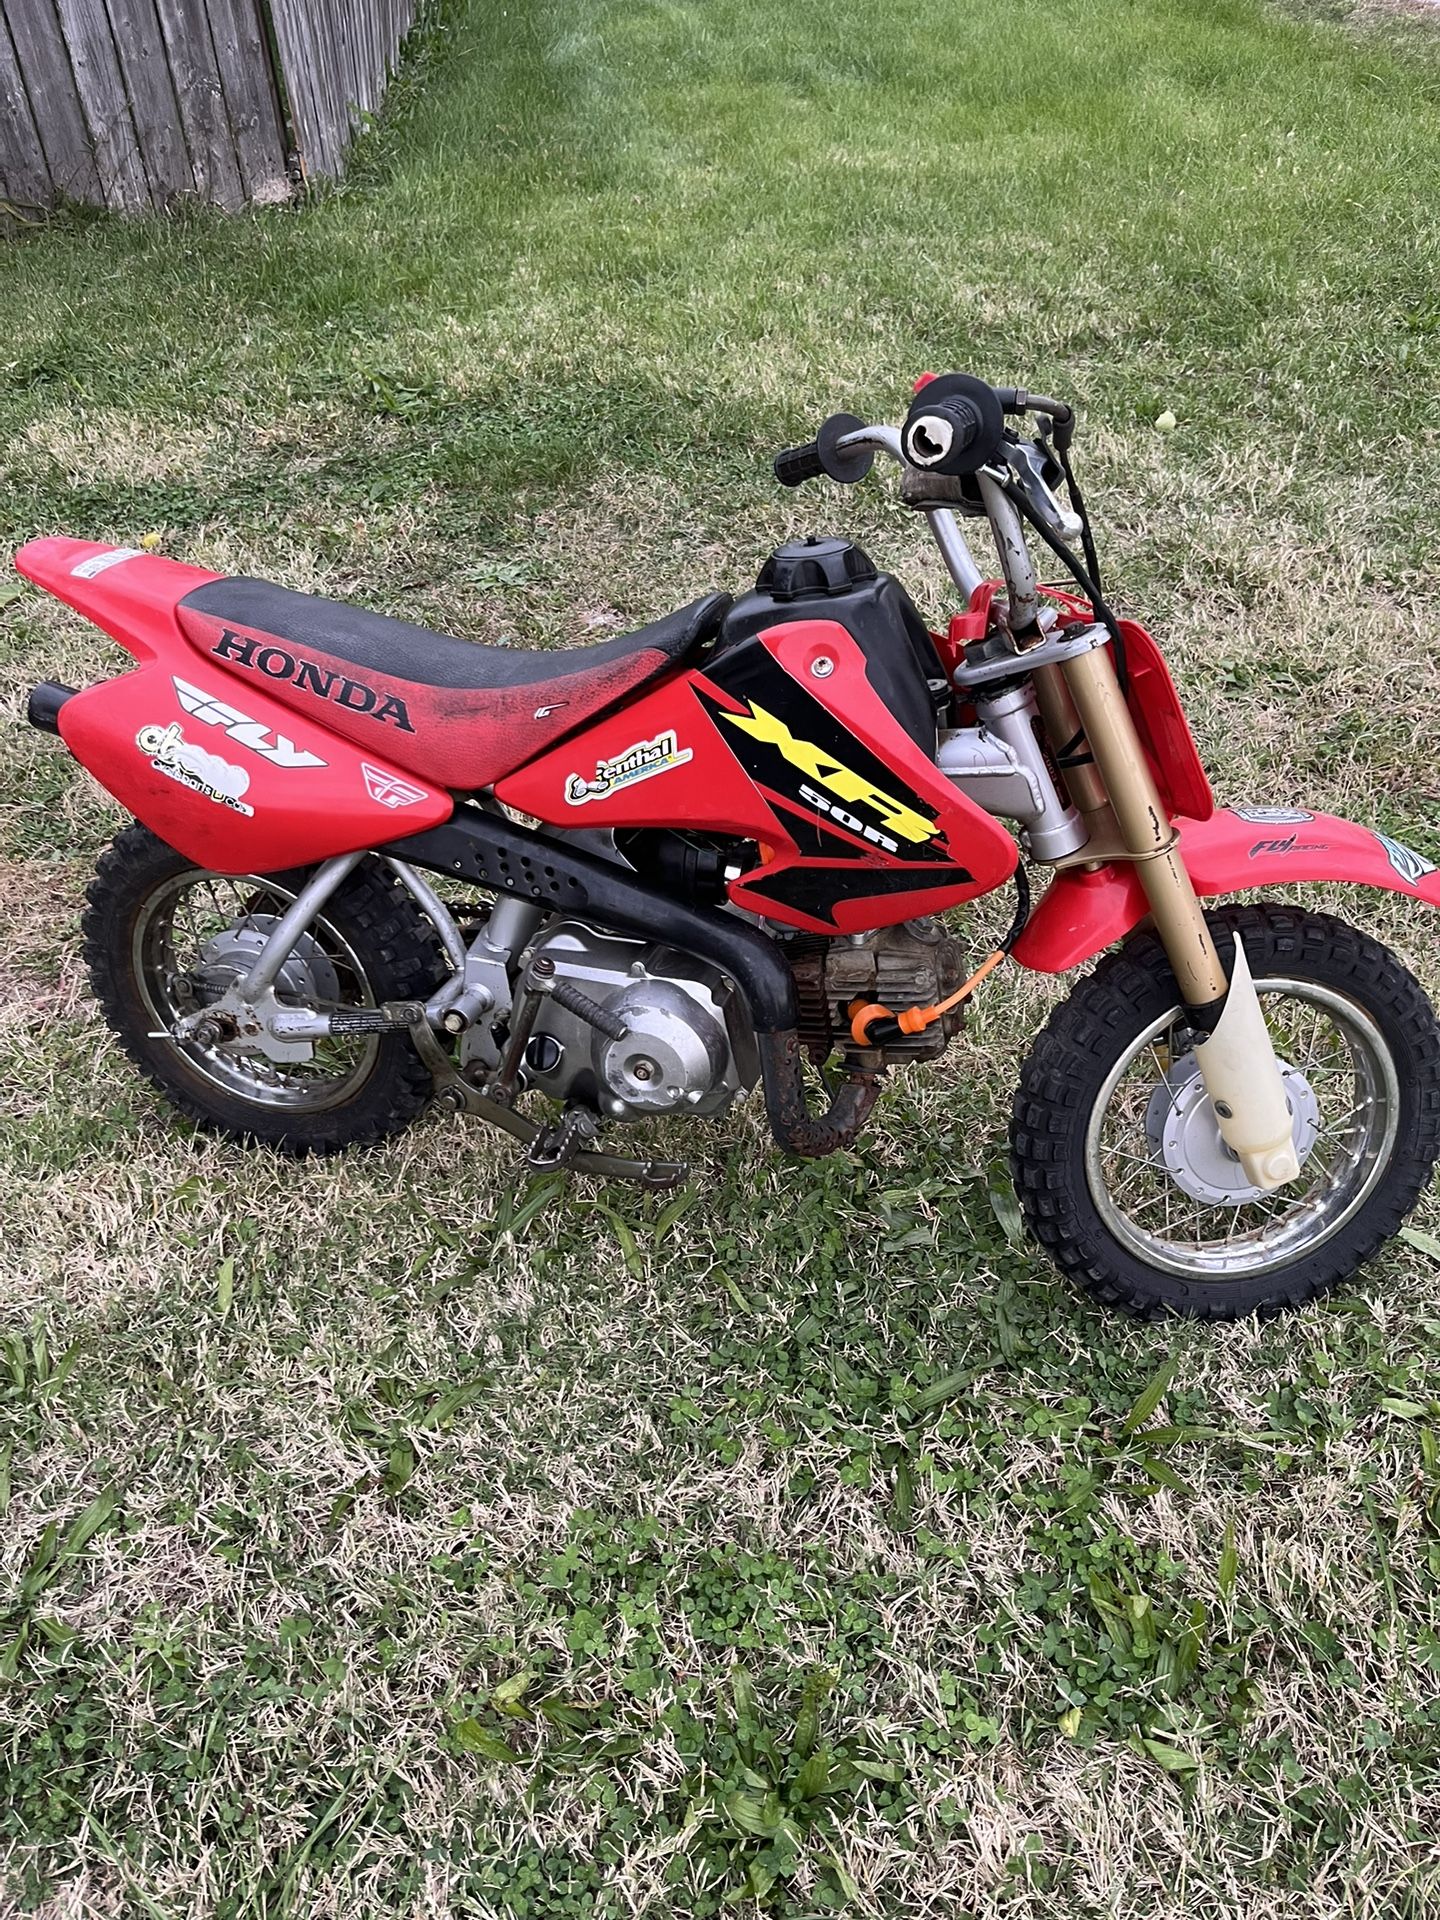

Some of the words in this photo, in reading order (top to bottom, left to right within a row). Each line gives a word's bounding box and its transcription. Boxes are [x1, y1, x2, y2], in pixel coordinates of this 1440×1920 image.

[211, 627, 416, 734] HONDA
[171, 675, 330, 768] FLY
[613, 756, 669, 785] AMERICA
[718, 699, 941, 843] XR
[798, 784, 899, 853] 50R
[1249, 833, 1297, 858] FLY
